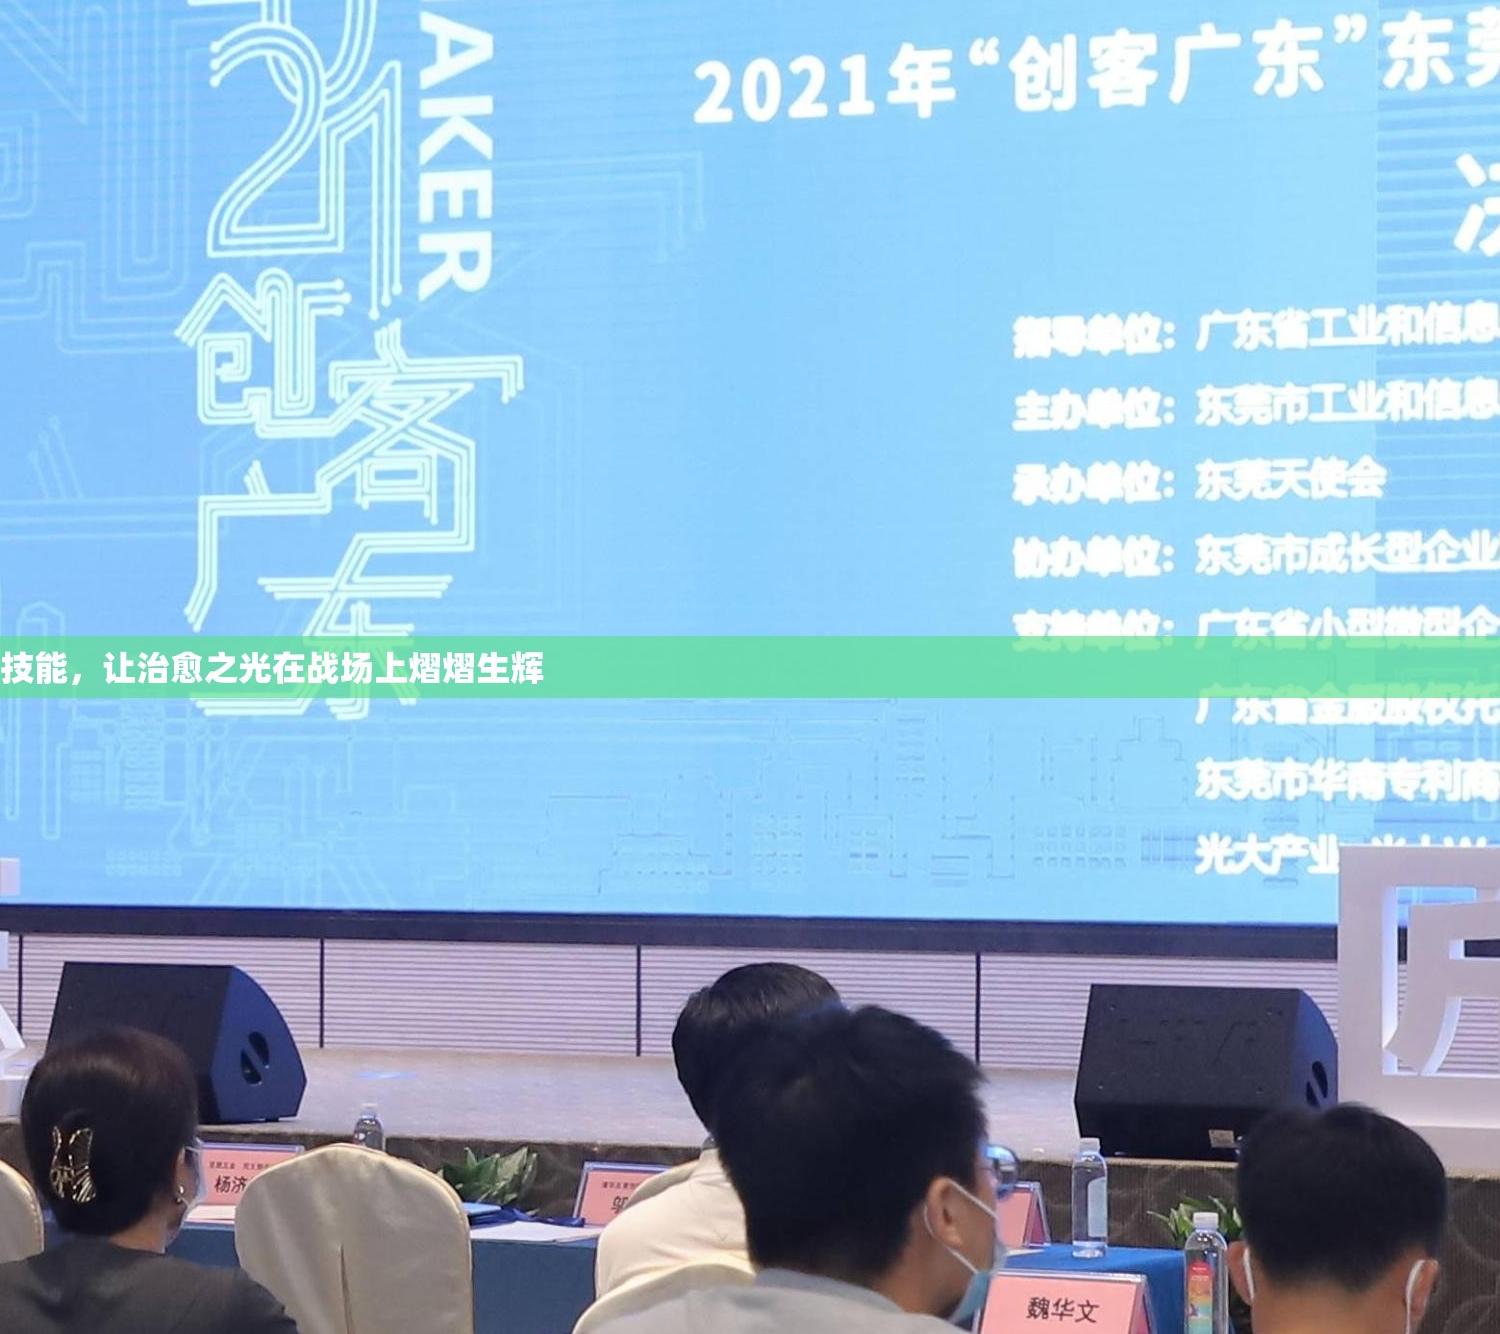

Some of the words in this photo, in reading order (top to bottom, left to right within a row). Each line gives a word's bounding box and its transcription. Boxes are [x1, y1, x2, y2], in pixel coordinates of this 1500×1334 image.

[1194, 453, 1388, 501] 东莞天使会
[1025, 1295, 1100, 1324] 魏华文
